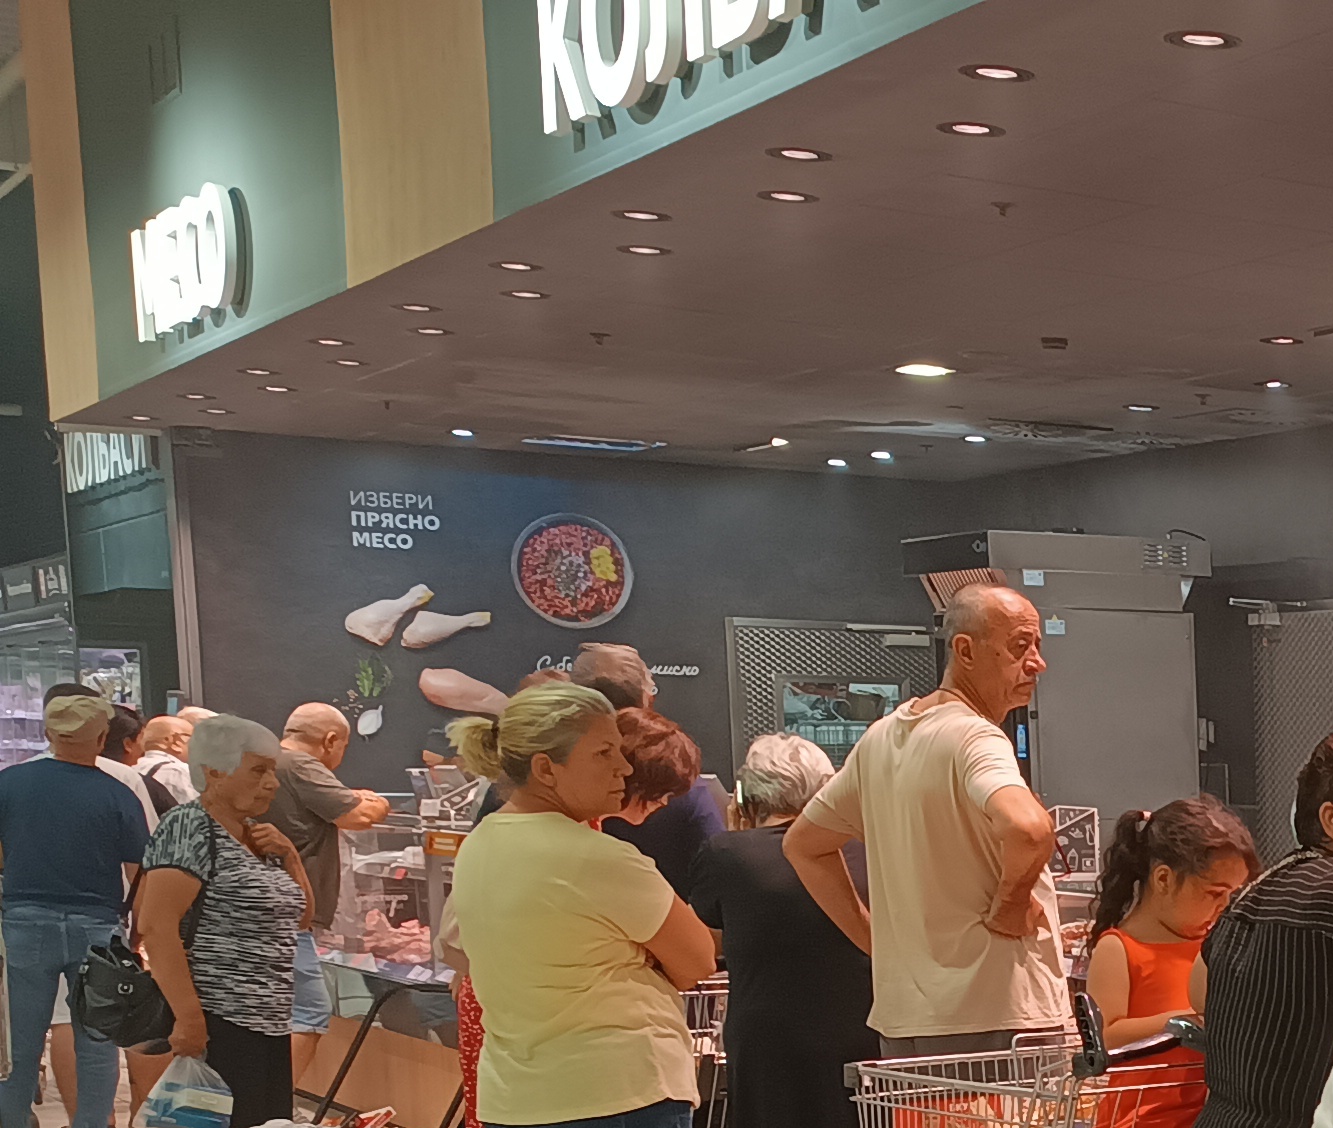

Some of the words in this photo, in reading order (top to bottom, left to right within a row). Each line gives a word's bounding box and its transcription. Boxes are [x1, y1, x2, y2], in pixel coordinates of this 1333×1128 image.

[537, 0, 792, 135] КОЛ
[131, 182, 232, 342] МЕСО
[64, 432, 146, 493] КОЛБАСИ
[349, 490, 433, 510] ИЗБЕРИ
[350, 510, 440, 531] ПРЯСНО
[352, 531, 413, 550] МЕСО
